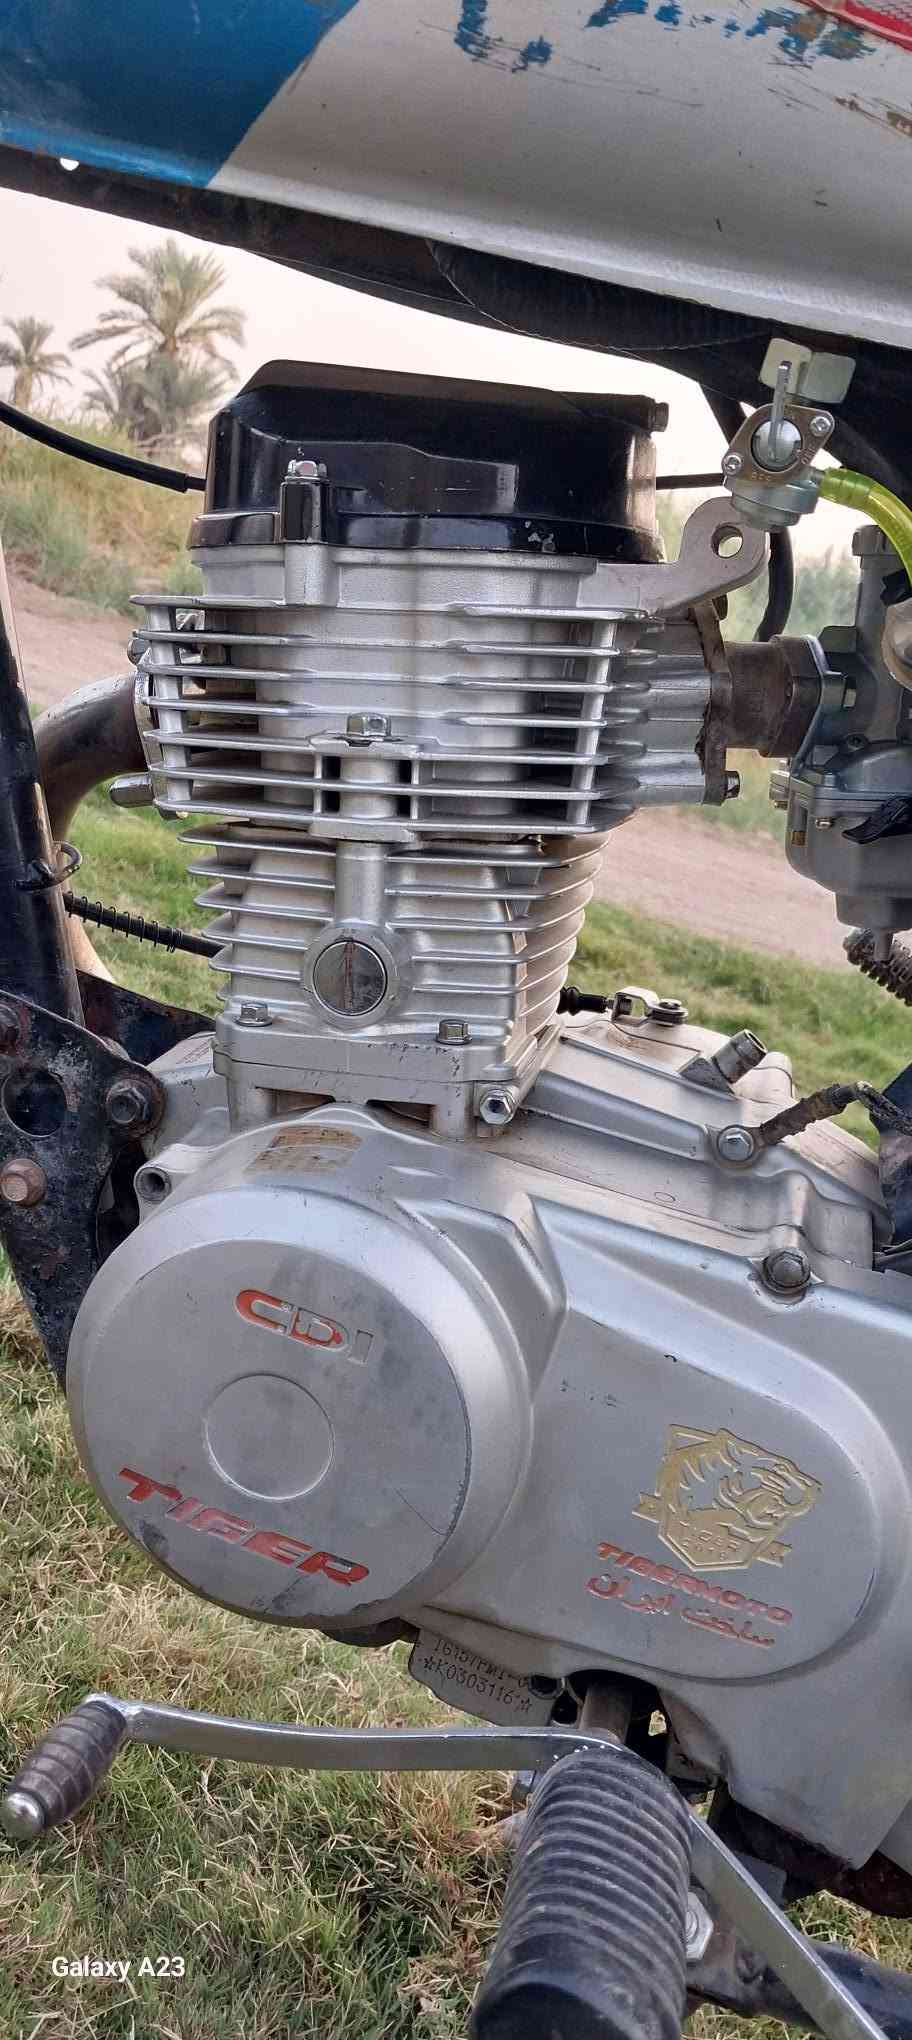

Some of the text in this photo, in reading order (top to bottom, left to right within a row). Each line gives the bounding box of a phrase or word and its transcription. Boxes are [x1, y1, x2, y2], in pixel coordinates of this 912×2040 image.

[234, 1289, 375, 1365] CDI
[118, 1467, 370, 1587] TIGER
[596, 1541, 793, 1626] TIGERMOTO
